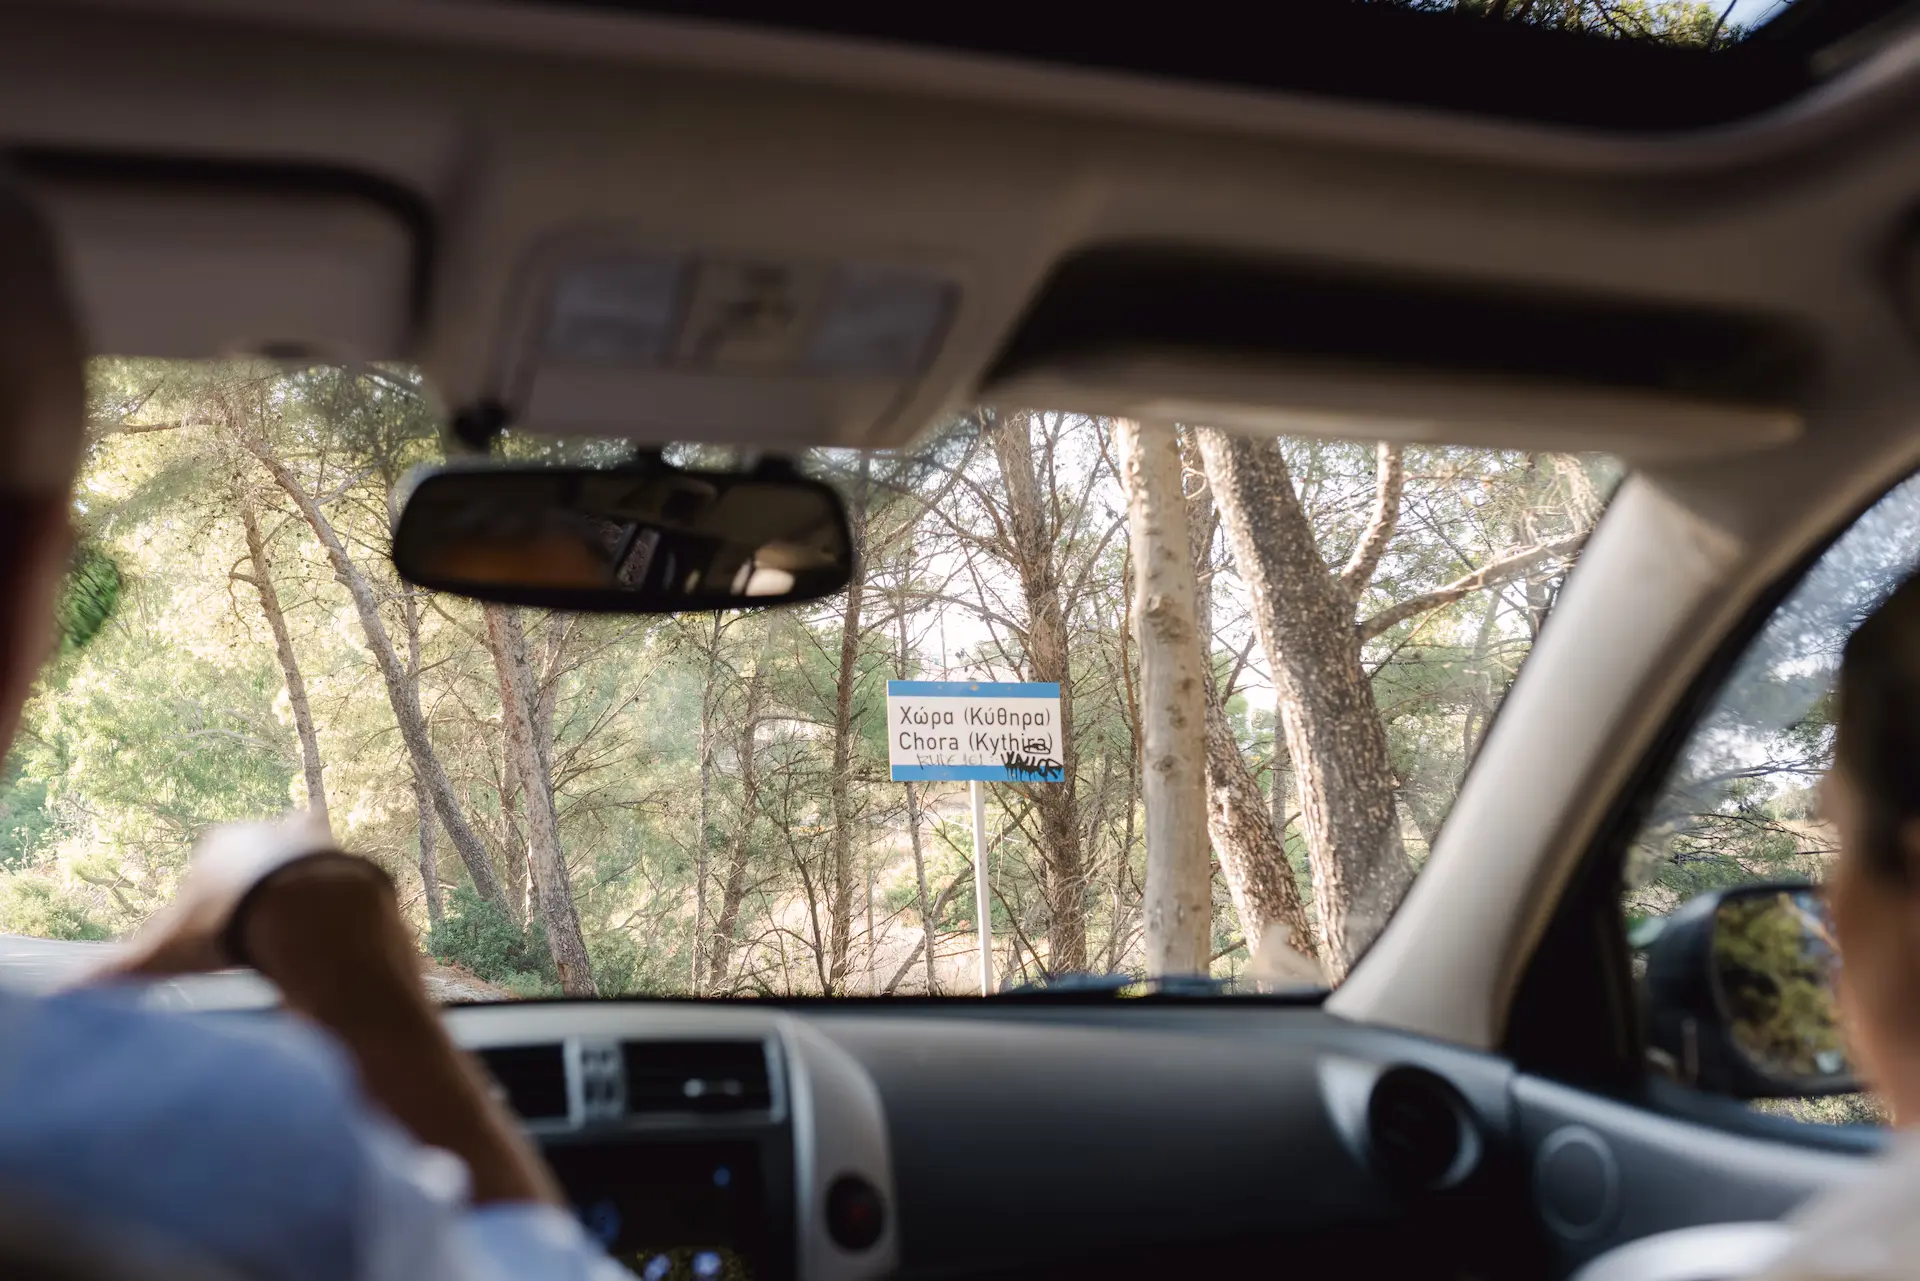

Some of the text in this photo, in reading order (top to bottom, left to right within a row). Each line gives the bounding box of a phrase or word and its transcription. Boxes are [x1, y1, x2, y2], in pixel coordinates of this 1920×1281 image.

[900, 706, 1050, 730] Χώρα (Κύθηρα)
[899, 731, 1053, 755] Chora (Kythira)
